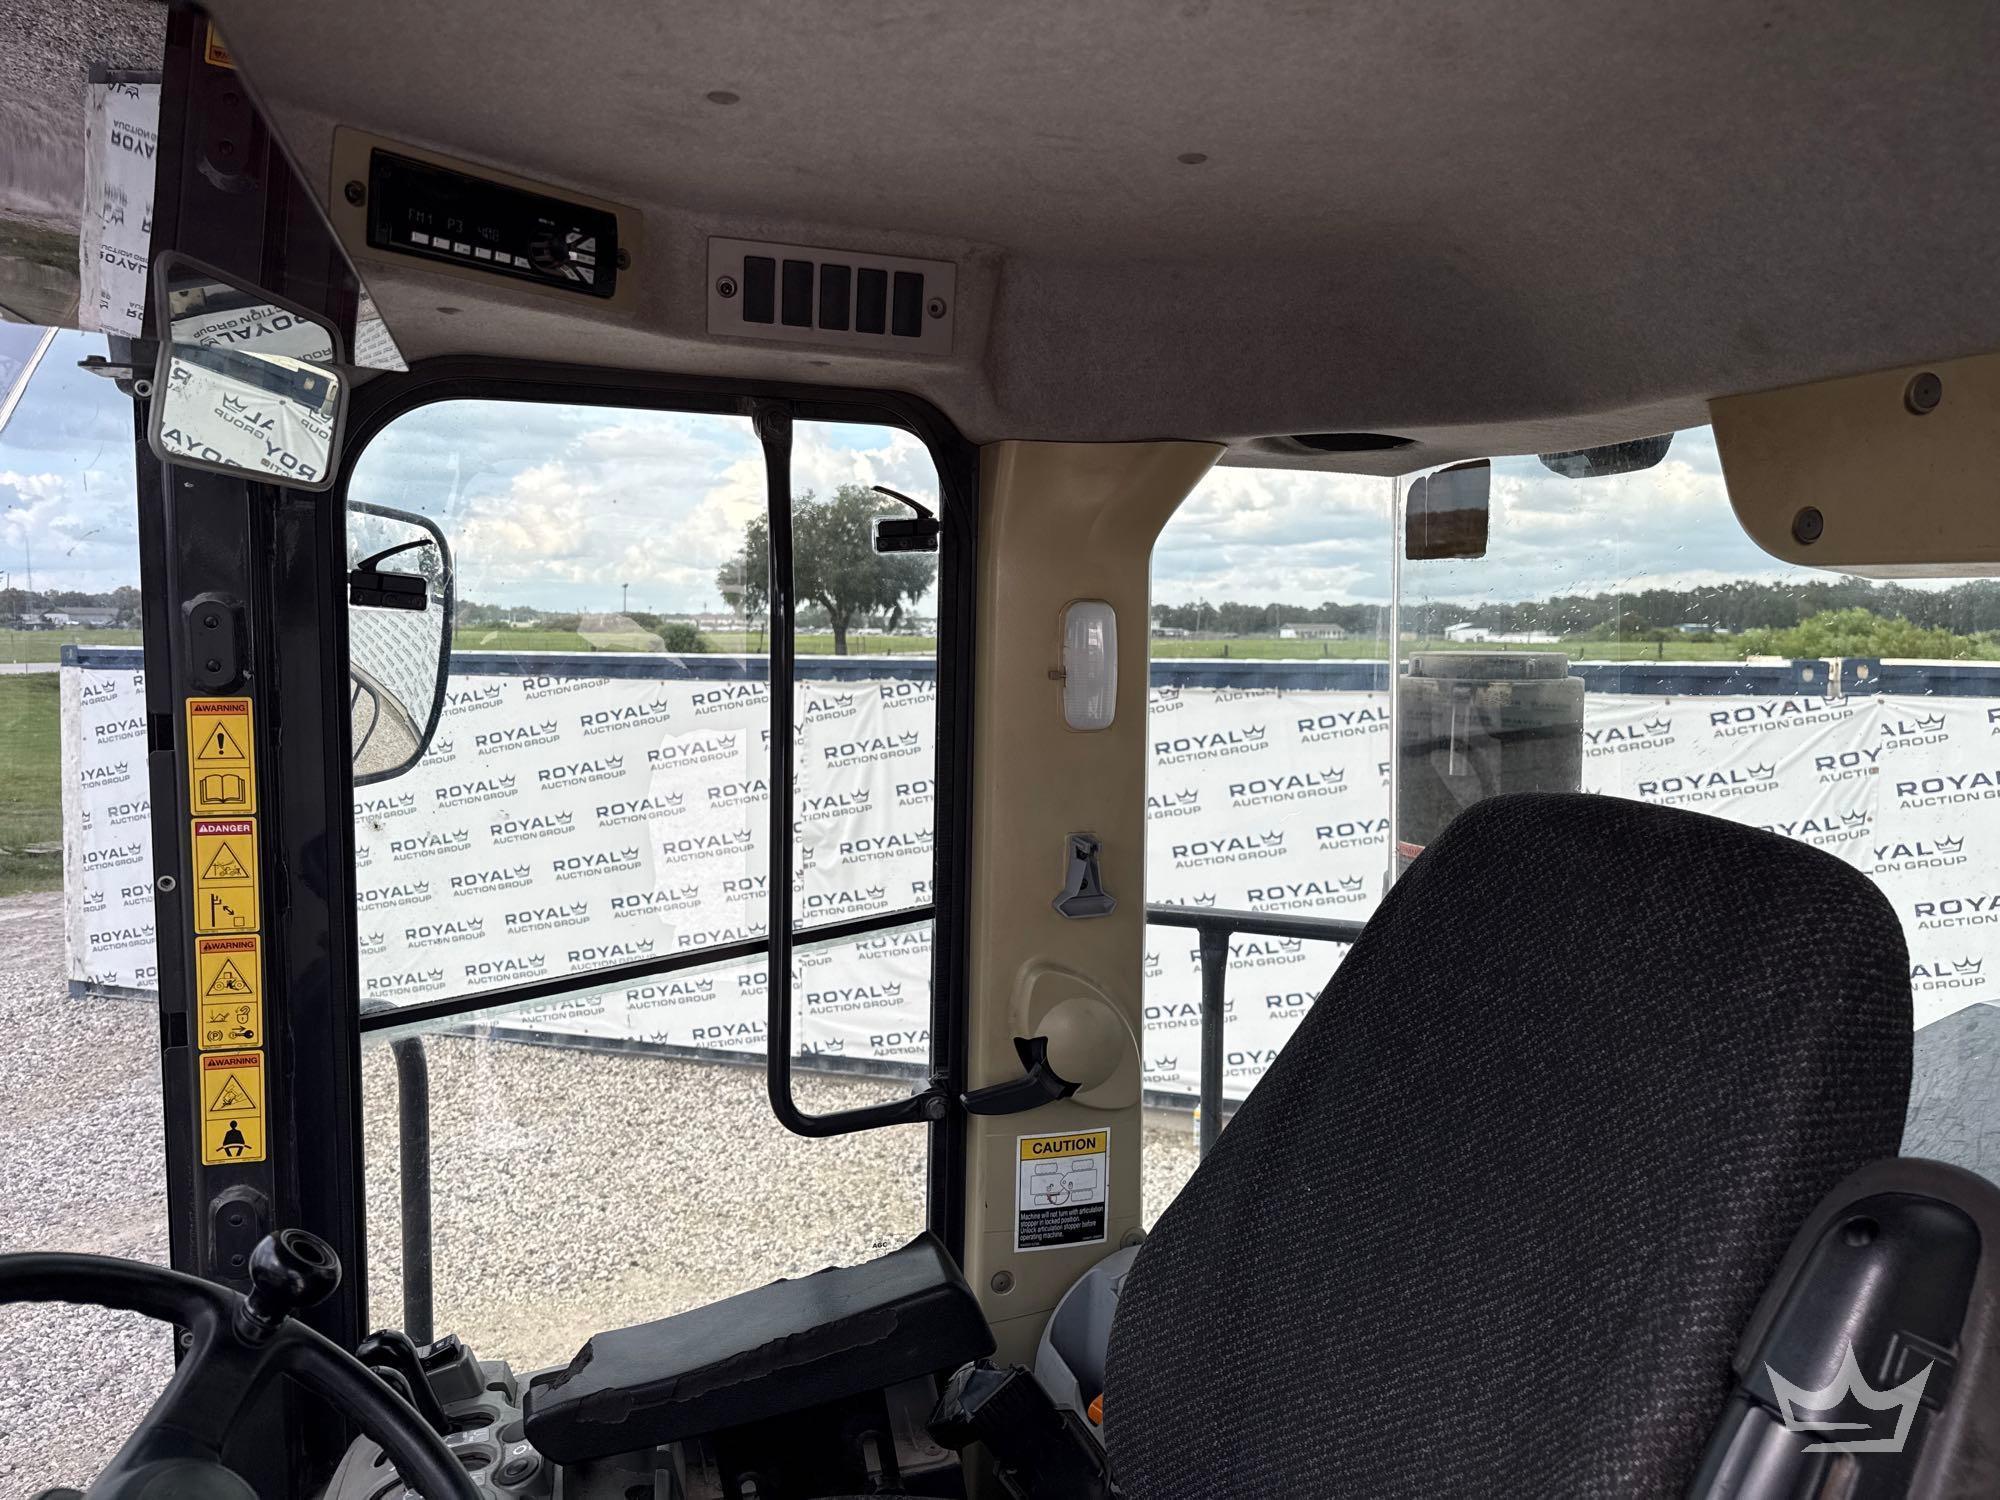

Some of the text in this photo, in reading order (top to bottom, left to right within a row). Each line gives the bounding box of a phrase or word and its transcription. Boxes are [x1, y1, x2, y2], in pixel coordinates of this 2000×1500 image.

[526, 678, 610, 700] AUCTION GROUP
[692, 683, 763, 706] ROYAL
[86, 693, 118, 705] GROUP
[201, 704, 246, 712] WARNING
[469, 699, 503, 714] GROUP
[695, 701, 744, 716] AUCTION
[581, 705, 650, 727] ROYAL
[818, 708, 856, 721] GROUP
[1298, 707, 1390, 733] ROYAL
[1710, 699, 1821, 727] ROYAL
[95, 717, 146, 737] ROYAL
[583, 714, 670, 737] AUCTION GROUP
[1713, 709, 1854, 739] AUCTION GROUP
[97, 732, 134, 744] AUCTION
[475, 725, 541, 747] ROYAL
[1155, 730, 1243, 755] ROYAL
[1301, 726, 1366, 744] AUCTION
[1886, 734, 1949, 749] GROUP
[478, 734, 560, 756] AUCTION GROUP
[647, 740, 717, 762] ROYAL
[824, 736, 899, 760] ROYAL
[1158, 741, 1269, 766] AUCTION GROUP
[1617, 737, 1675, 753] GROUP
[423, 754, 456, 768] GROUP
[650, 750, 738, 772] AUCTION GROUP
[827, 746, 921, 769] AUCTION GROUP
[538, 759, 606, 782] ROYAL
[541, 769, 627, 791] AUCTION GROUP
[102, 775, 130, 786] GROUP
[436, 778, 500, 800] ROYAL
[1229, 773, 1321, 798] ROYAL
[1638, 770, 1748, 797] ROYAL
[1719, 781, 1779, 797] GROUP
[438, 788, 519, 809] AUCTION GROUP
[710, 795, 760, 809] AUCTION
[1232, 784, 1348, 809] AUCTION GROUP
[1900, 791, 1979, 809] AUCTION
[383, 806, 417, 820] GROUP
[596, 796, 666, 818] ROYAL
[832, 804, 872, 818] GROUP
[1154, 805, 1201, 820] GROUP
[110, 813, 146, 825] AUCTION
[490, 816, 556, 836] ROYAL
[599, 807, 686, 828] AUCTION GROUP
[208, 824, 250, 833] DANGER
[493, 825, 576, 846] AUCTION GROUP
[1813, 829, 1870, 844] GROUP
[390, 832, 453, 853] ROYAL
[393, 842, 471, 862] AUCTION GROUP
[663, 834, 733, 855] ROYAL
[839, 832, 914, 856] ROYAL
[1172, 835, 1261, 859] ROYAL
[1319, 835, 1385, 851] AUCTION
[115, 856, 143, 867] GROUP
[554, 851, 621, 872] ROYAL
[666, 844, 754, 865] AUCTION GROUP
[841, 852, 895, 865] AUCTION
[1175, 847, 1287, 870] AUCTION GROUP
[1904, 856, 1967, 870] GROUP
[451, 868, 514, 888] ROYAL
[556, 862, 642, 881] AUCTION GROUP
[453, 878, 533, 897] AUCTION GROUP
[726, 890, 767, 903] AUCTIO
[1247, 879, 1340, 903] ROYAL
[398, 894, 432, 907] GROUP
[611, 889, 681, 910] ROYAL
[802, 890, 862, 909] OYAL
[847, 901, 888, 914] GROUP
[1251, 893, 1367, 913] AUCTION GROUP
[505, 906, 572, 925] ROYAL
[614, 900, 702, 919] AUCTION GROUP
[405, 920, 468, 940] ROYAL
[507, 916, 591, 935] AUCTION GROUP
[1918, 915, 1998, 930] AUCTION
[90, 927, 142, 944] ROYAL
[407, 931, 486, 949] AUCTION GROUP
[678, 928, 749, 948] ROYAL
[92, 942, 128, 952] AUCTION
[210, 941, 255, 950] WARNING
[568, 943, 636, 963] ROYAL
[858, 948, 910, 960] AUCTION
[465, 958, 529, 977] ROYAL
[1258, 954, 1306, 967] GROUP
[366, 970, 428, 990] ROYAL
[467, 968, 548, 985] AUCTION GROUP
[1923, 977, 1986, 991] GROUP
[369, 982, 446, 998] AUCTION GROUP
[627, 982, 696, 1001] ROYAL
[807, 985, 882, 1006] ROYAL
[629, 993, 716, 1010] AUCTION GROUP
[809, 997, 904, 1015] AUCTION GROUP
[522, 1007, 605, 1024] AUCTION GROUP
[692, 1022, 758, 1041] ROYAL
[696, 1037, 744, 1049] AUCTION
[215, 1057, 258, 1066] WARNING
[1032, 1137, 1096, 1154] CAUTION
[1082, 1220, 1096, 1228] before
[871, 1241, 888, 1249] AGC
